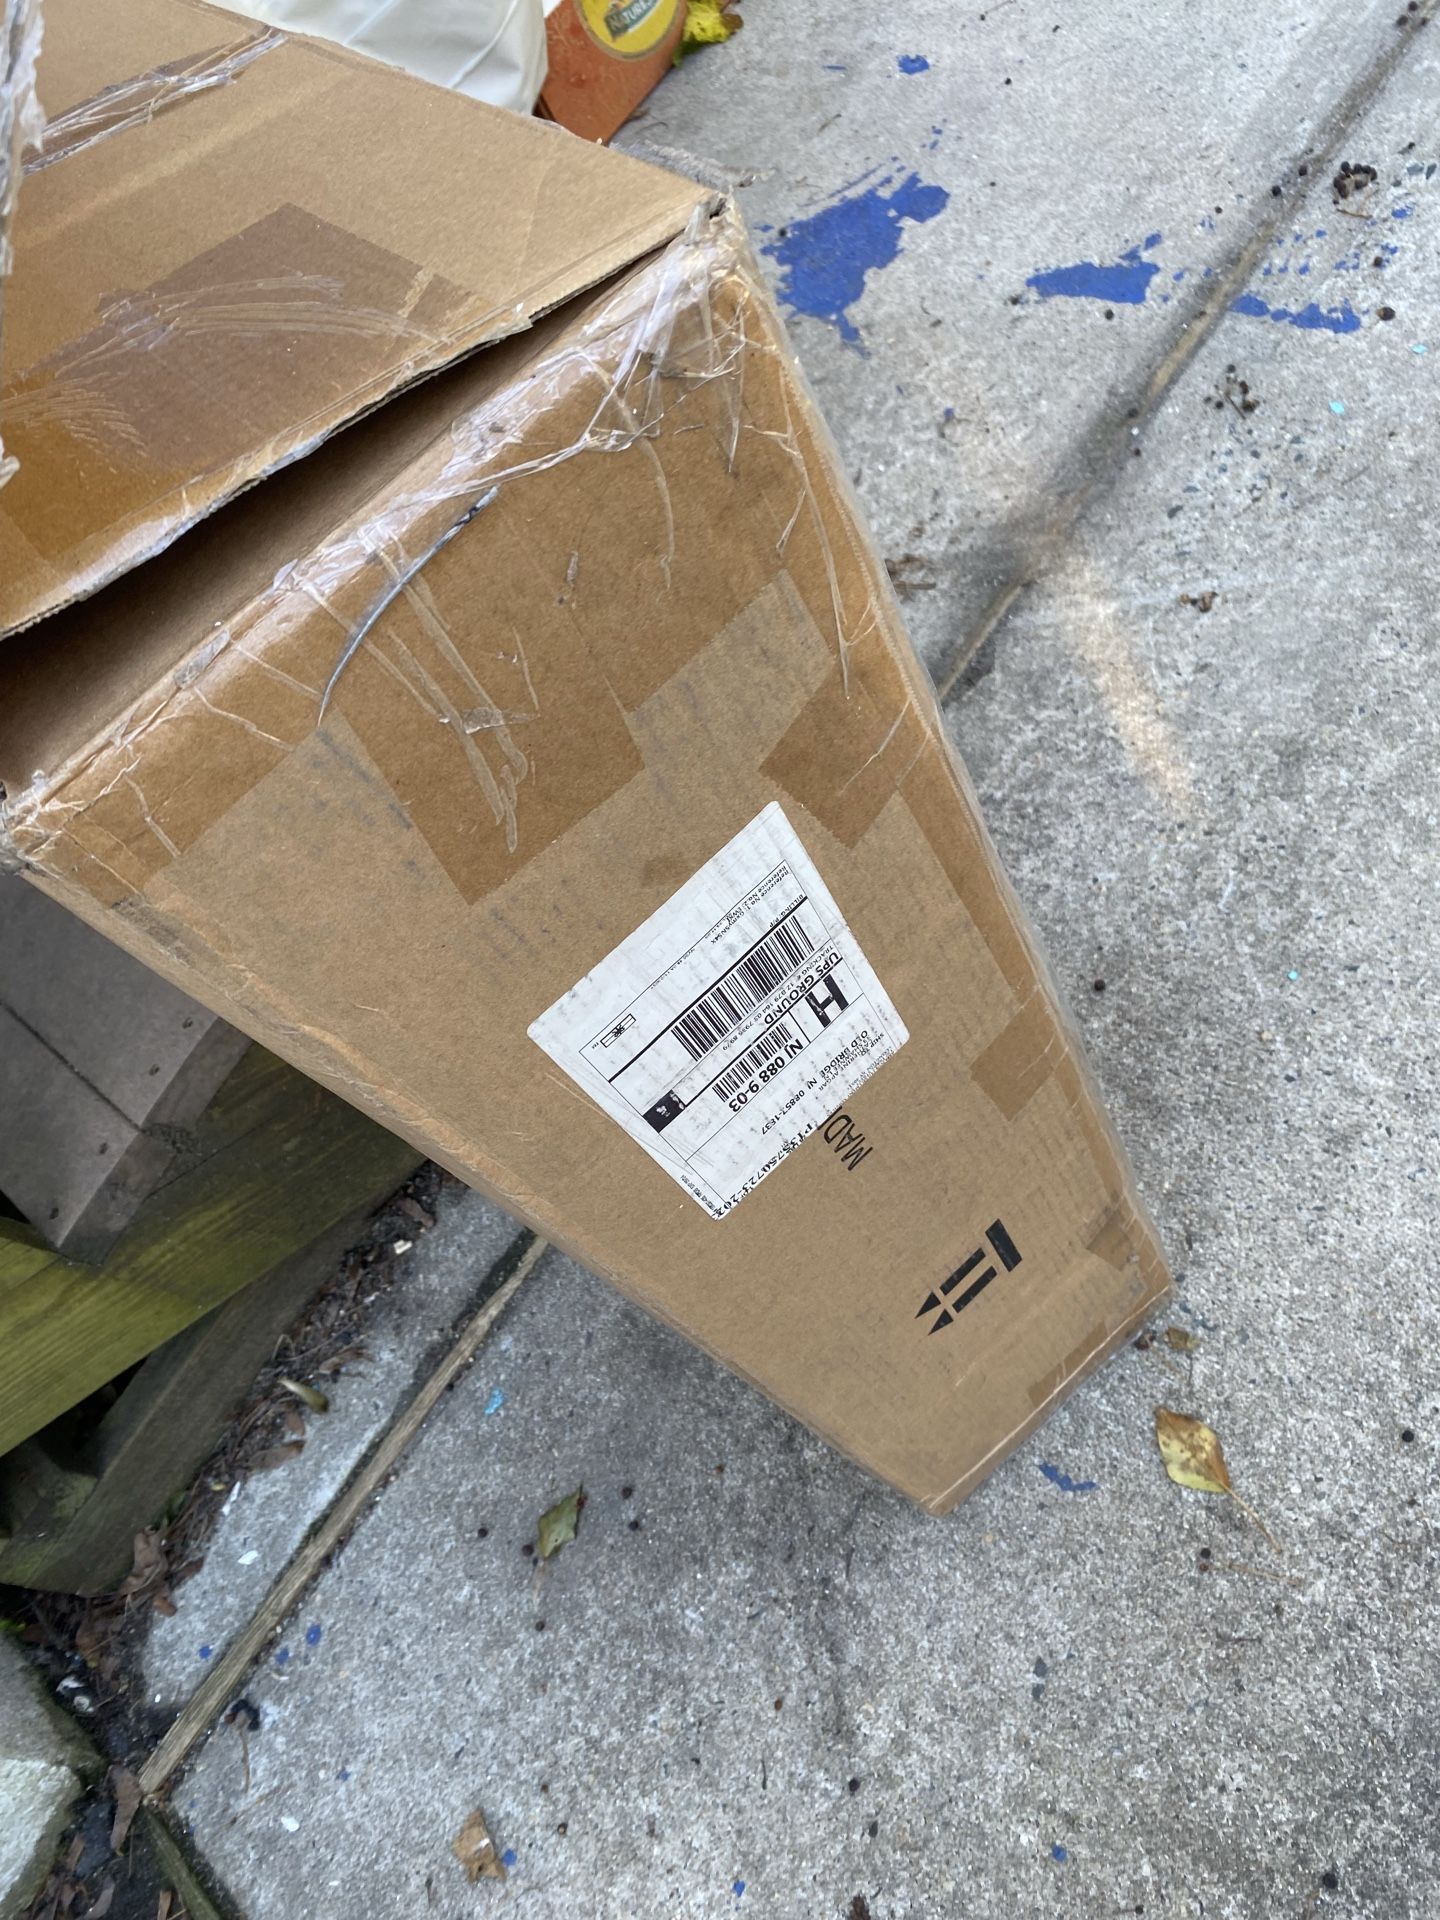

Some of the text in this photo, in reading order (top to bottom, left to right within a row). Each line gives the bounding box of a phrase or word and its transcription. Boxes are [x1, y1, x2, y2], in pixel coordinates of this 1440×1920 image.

[756, 864, 786, 894] Reference
[759, 868, 789, 898] Reference
[800, 944, 833, 976] TRACKING
[762, 950, 839, 1026] UPS GROUND
[803, 972, 849, 1028] H
[839, 1037, 873, 1071] CATHERINE
[849, 1028, 868, 1049] OLD
[868, 1031, 884, 1048] SHIP
[726, 1035, 804, 1114] NJ 088 9-03
[818, 1045, 850, 1078] BRIDGE
[804, 1075, 817, 1090] NJ
[817, 1069, 839, 1092] APGAR
